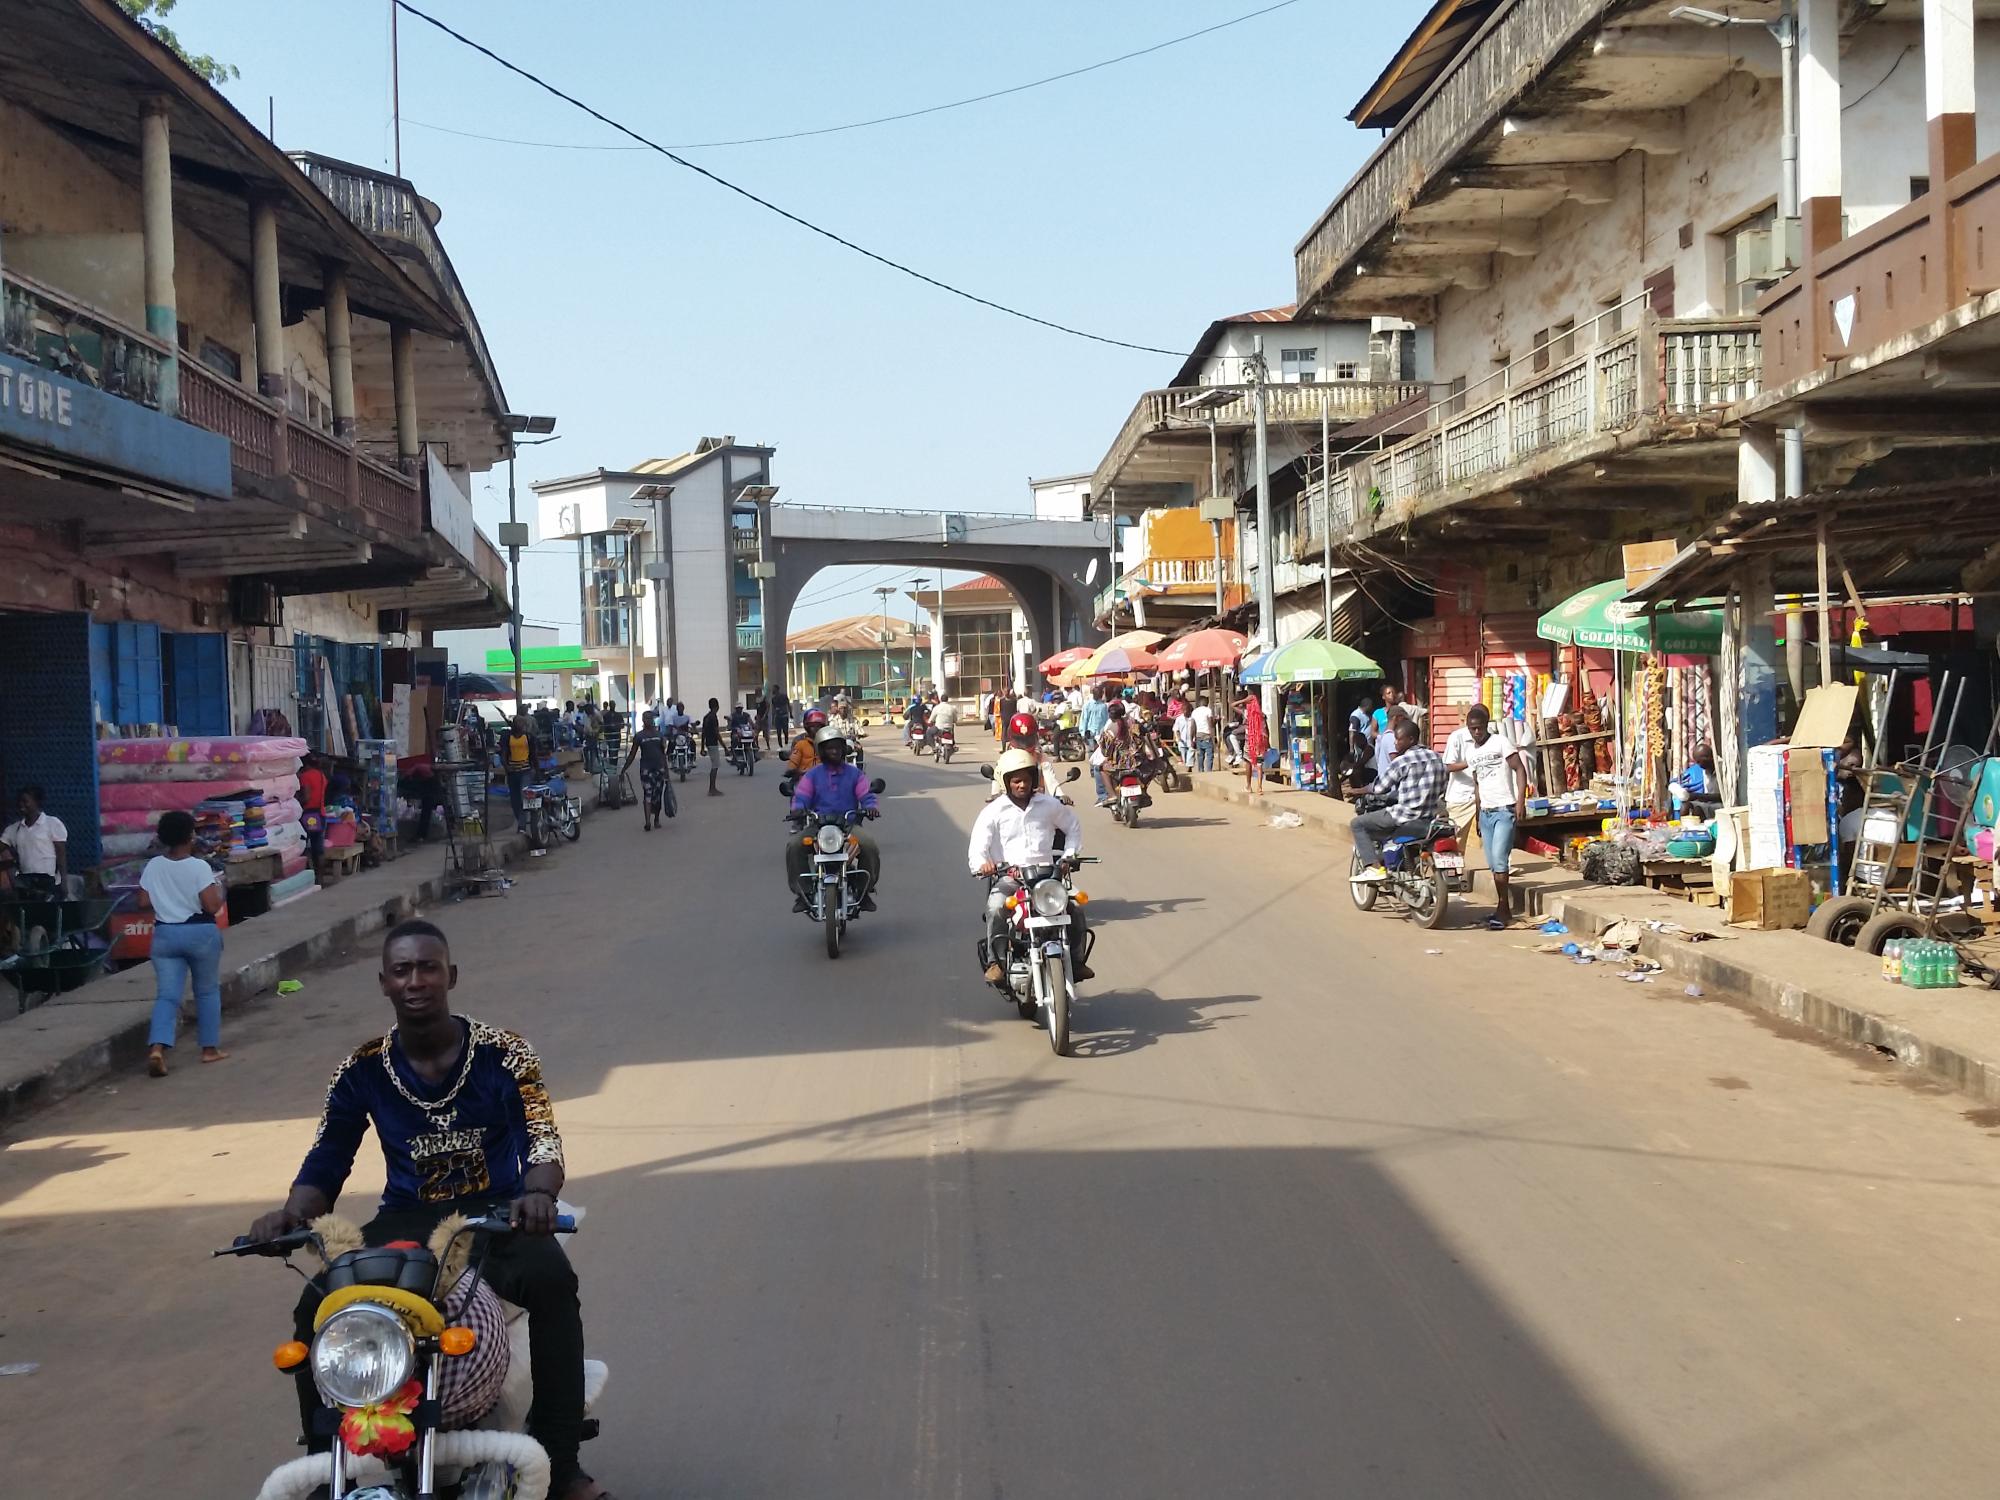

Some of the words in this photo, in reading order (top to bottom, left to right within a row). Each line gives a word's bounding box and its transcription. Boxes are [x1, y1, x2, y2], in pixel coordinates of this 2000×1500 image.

[1579, 631, 1614, 643] GOLD
[1615, 635, 1648, 648] SEAL
[415, 1149, 491, 1201] 23
